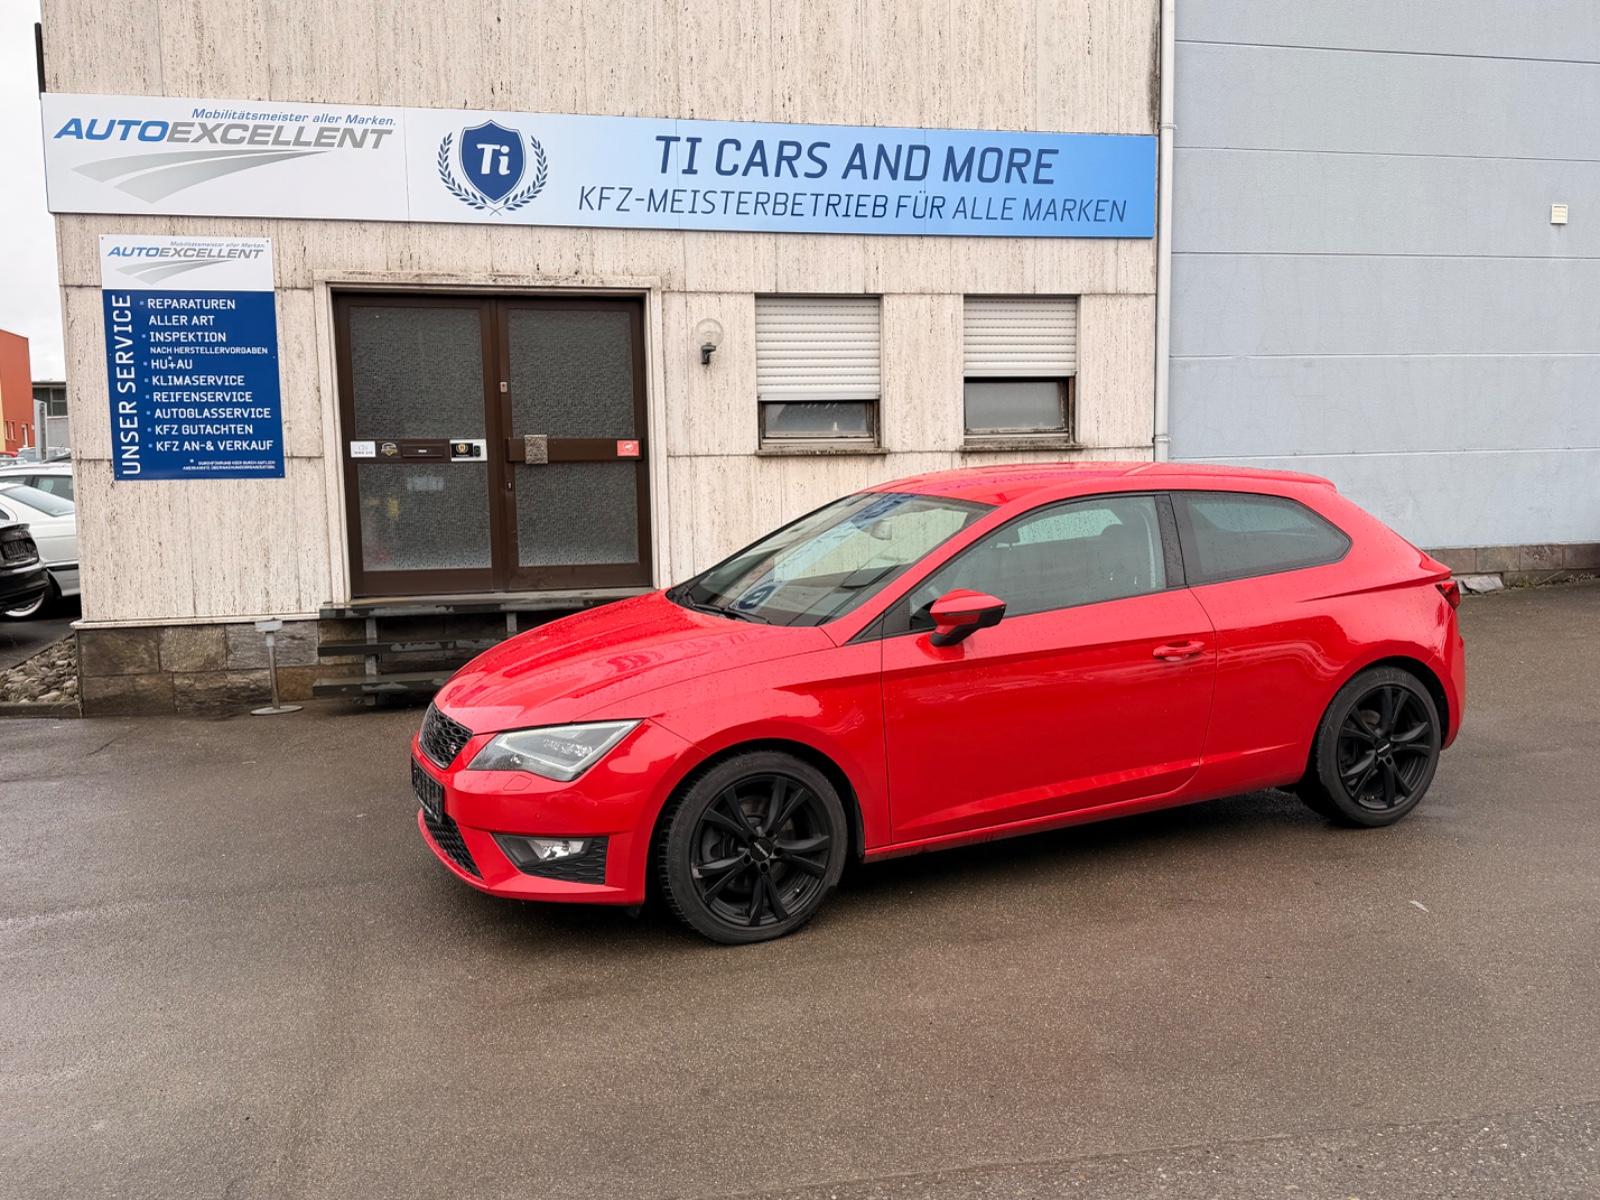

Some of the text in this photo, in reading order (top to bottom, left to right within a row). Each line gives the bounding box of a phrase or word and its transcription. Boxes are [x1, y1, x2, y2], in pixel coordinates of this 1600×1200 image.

[191, 108, 396, 126] Mobilitätsmeister aller Marken.
[54, 117, 394, 149] AUTOEXCELLENT
[476, 143, 511, 176] Ti
[655, 135, 1059, 185] TI CARS AND MORE
[579, 186, 1127, 222] KFZ-MEISTERBETRIEB FÜR ALLE MARKEN
[108, 246, 264, 259] AUTOEXCELLENT
[147, 298, 236, 310] REPARATUREN
[148, 315, 215, 326] ALLER ART
[150, 331, 227, 342] INSPEKTION
[150, 346, 268, 354] NACH HERSTELLERVORGABEN
[112, 295, 141, 475] UNSER SERVICE
[152, 375, 245, 386] KLIMASERVICE
[153, 391, 253, 402] REIFENSERVICE
[154, 408, 271, 419] AUTOGLASSERVICE
[155, 424, 253, 435] KFZ GUTACHTEN
[156, 441, 180, 452] KFZ
[217, 440, 274, 451] VERKAUF
